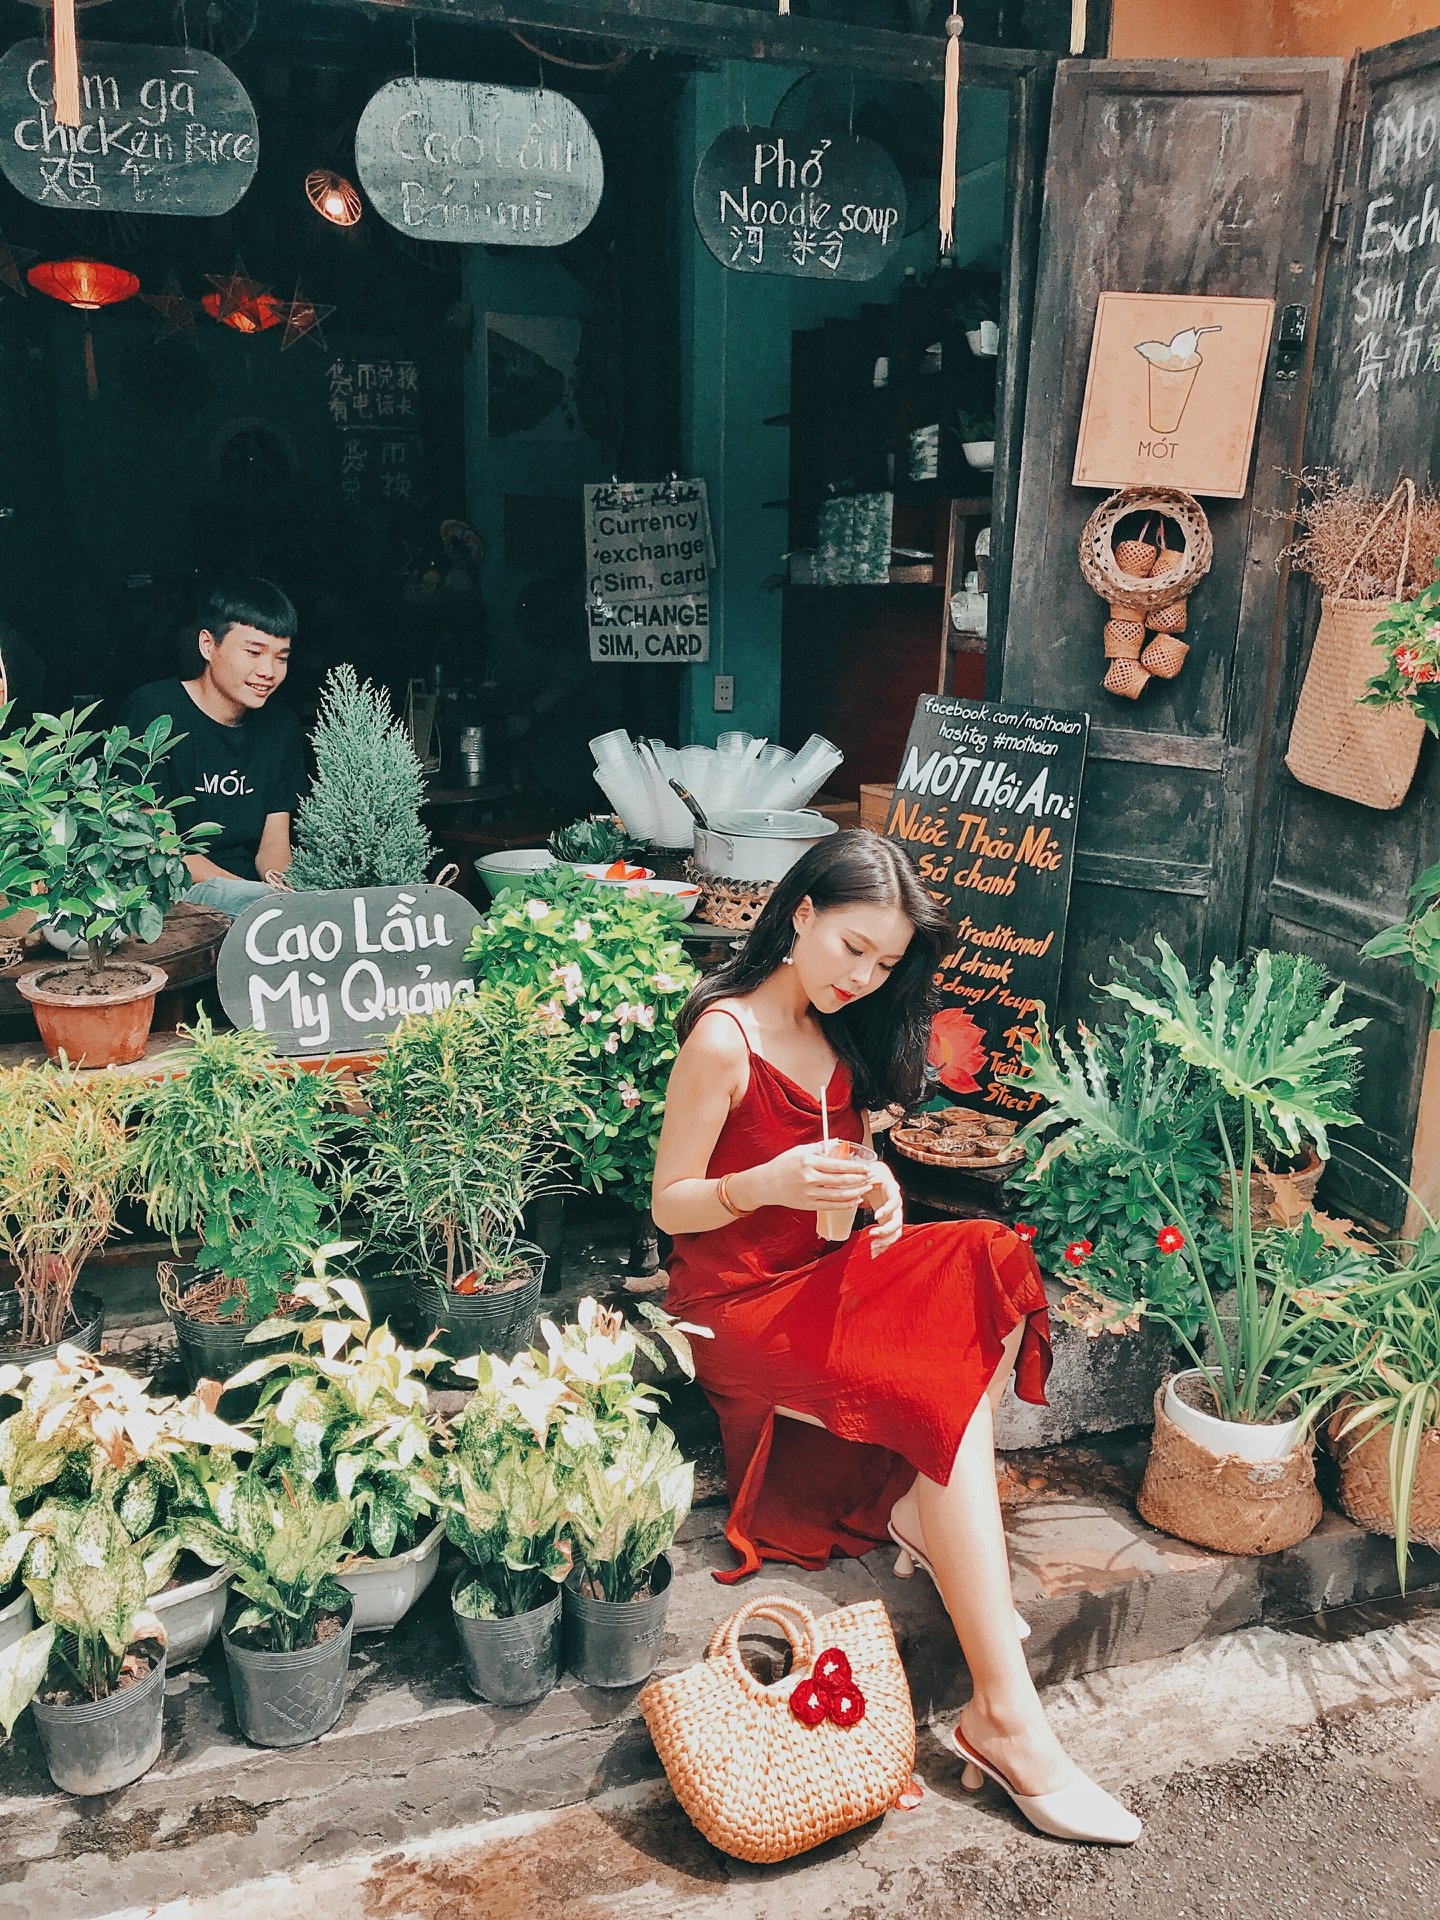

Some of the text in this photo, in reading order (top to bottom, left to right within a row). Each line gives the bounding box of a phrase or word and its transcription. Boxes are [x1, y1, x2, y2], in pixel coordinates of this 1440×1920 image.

[27, 59, 119, 110] Cm
[185, 122, 254, 165] Rice
[391, 110, 485, 167] Cao
[754, 138, 832, 189] Phở
[719, 186, 899, 246] Noodle soup
[1358, 183, 1440, 260] Exch
[1137, 437, 1179, 459] MÓT
[599, 510, 699, 536] Currency
[660, 563, 706, 587] card
[589, 603, 709, 627] EXCHANGE
[598, 633, 703, 660] SIM, CARD
[924, 697, 1083, 736] facebook.com/mothoian
[938, 720, 1060, 757] hashtag #mothoian
[896, 745, 982, 803] MÓT
[970, 760, 1024, 815] Hội
[955, 812, 1015, 861] Thảo
[1013, 824, 1064, 876] Mộc
[953, 858, 1018, 898] chanh
[244, 891, 455, 966] Cao Lầu
[956, 915, 1055, 958] traditional
[959, 949, 1015, 985] drink
[982, 1082, 1043, 1113] Street
